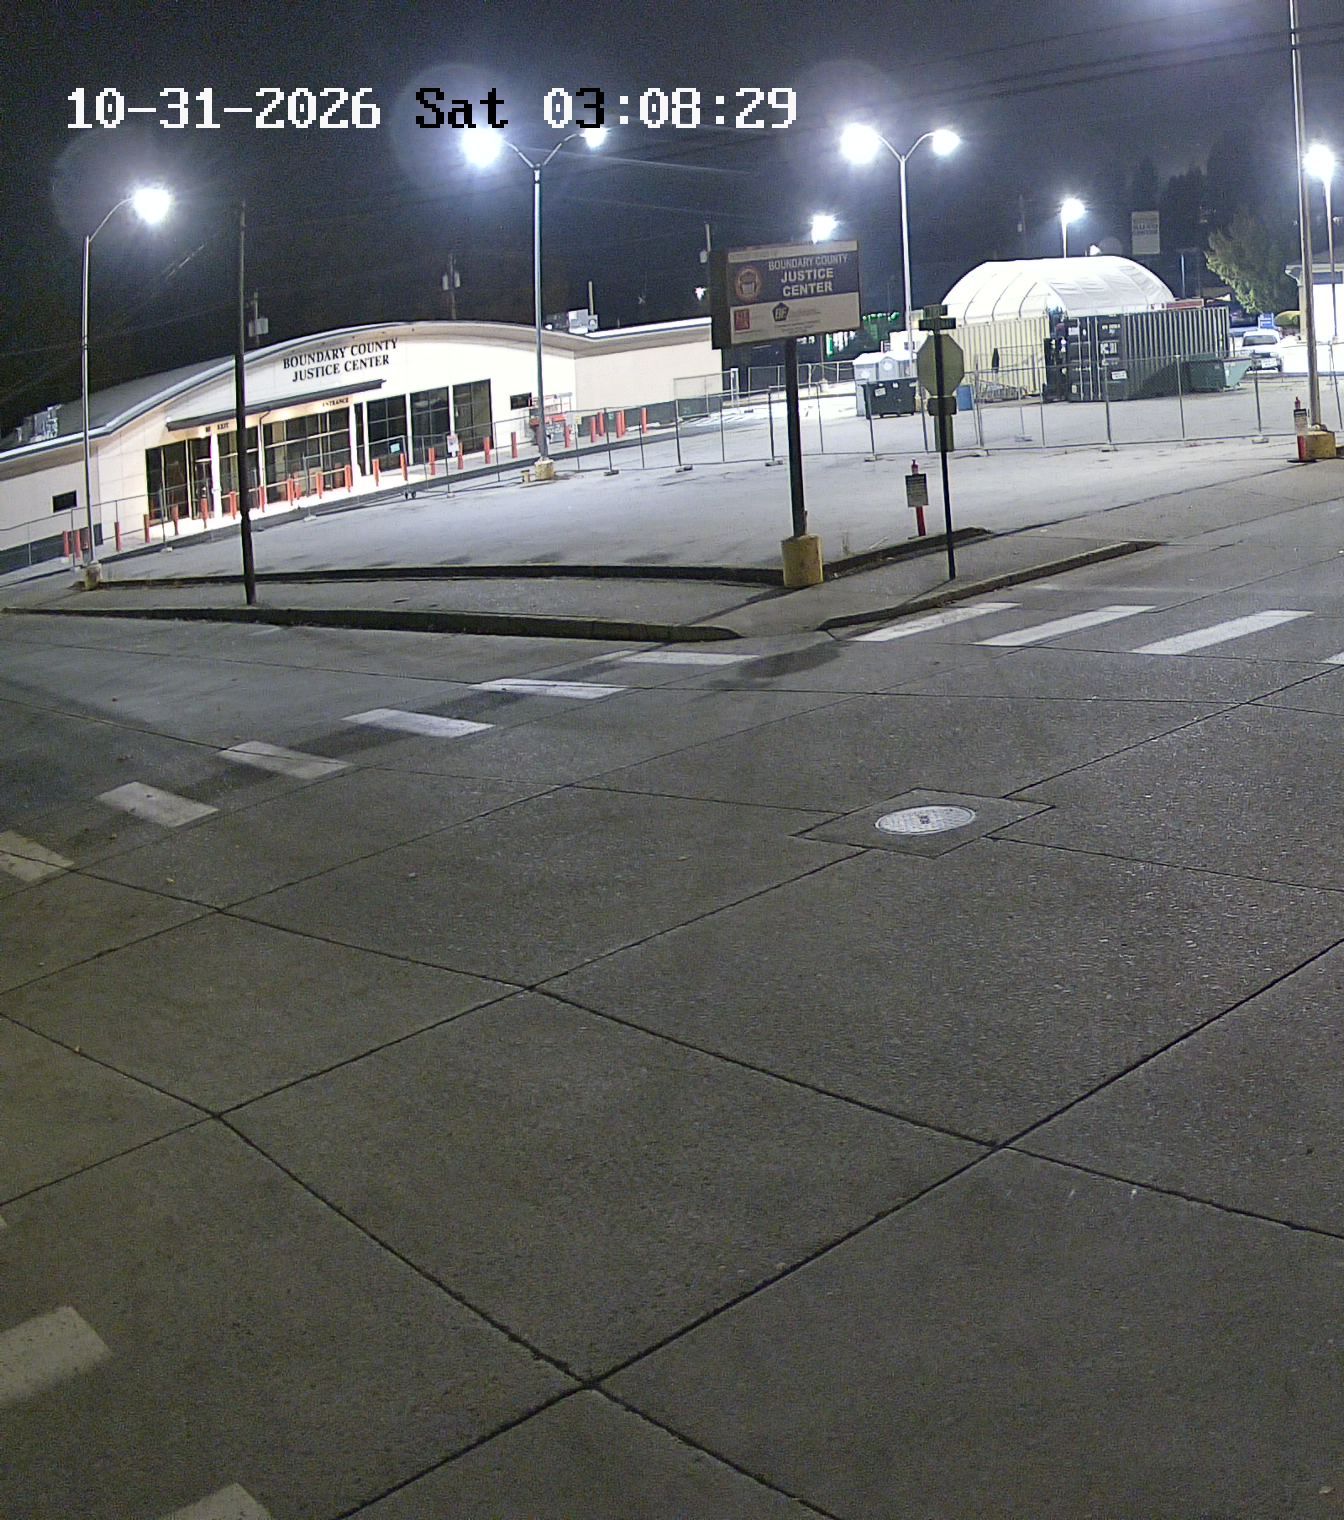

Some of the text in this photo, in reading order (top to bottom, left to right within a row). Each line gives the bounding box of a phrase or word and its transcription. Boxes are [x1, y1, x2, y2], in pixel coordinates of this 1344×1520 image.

[768, 253, 848, 271] BOUNDARY COUNTY
[781, 267, 834, 283] JUSTICE
[783, 281, 833, 297] CENTER
[283, 338, 398, 369] BOUNDARY COUNTY
[292, 354, 390, 382] JUSTICE CENTER
